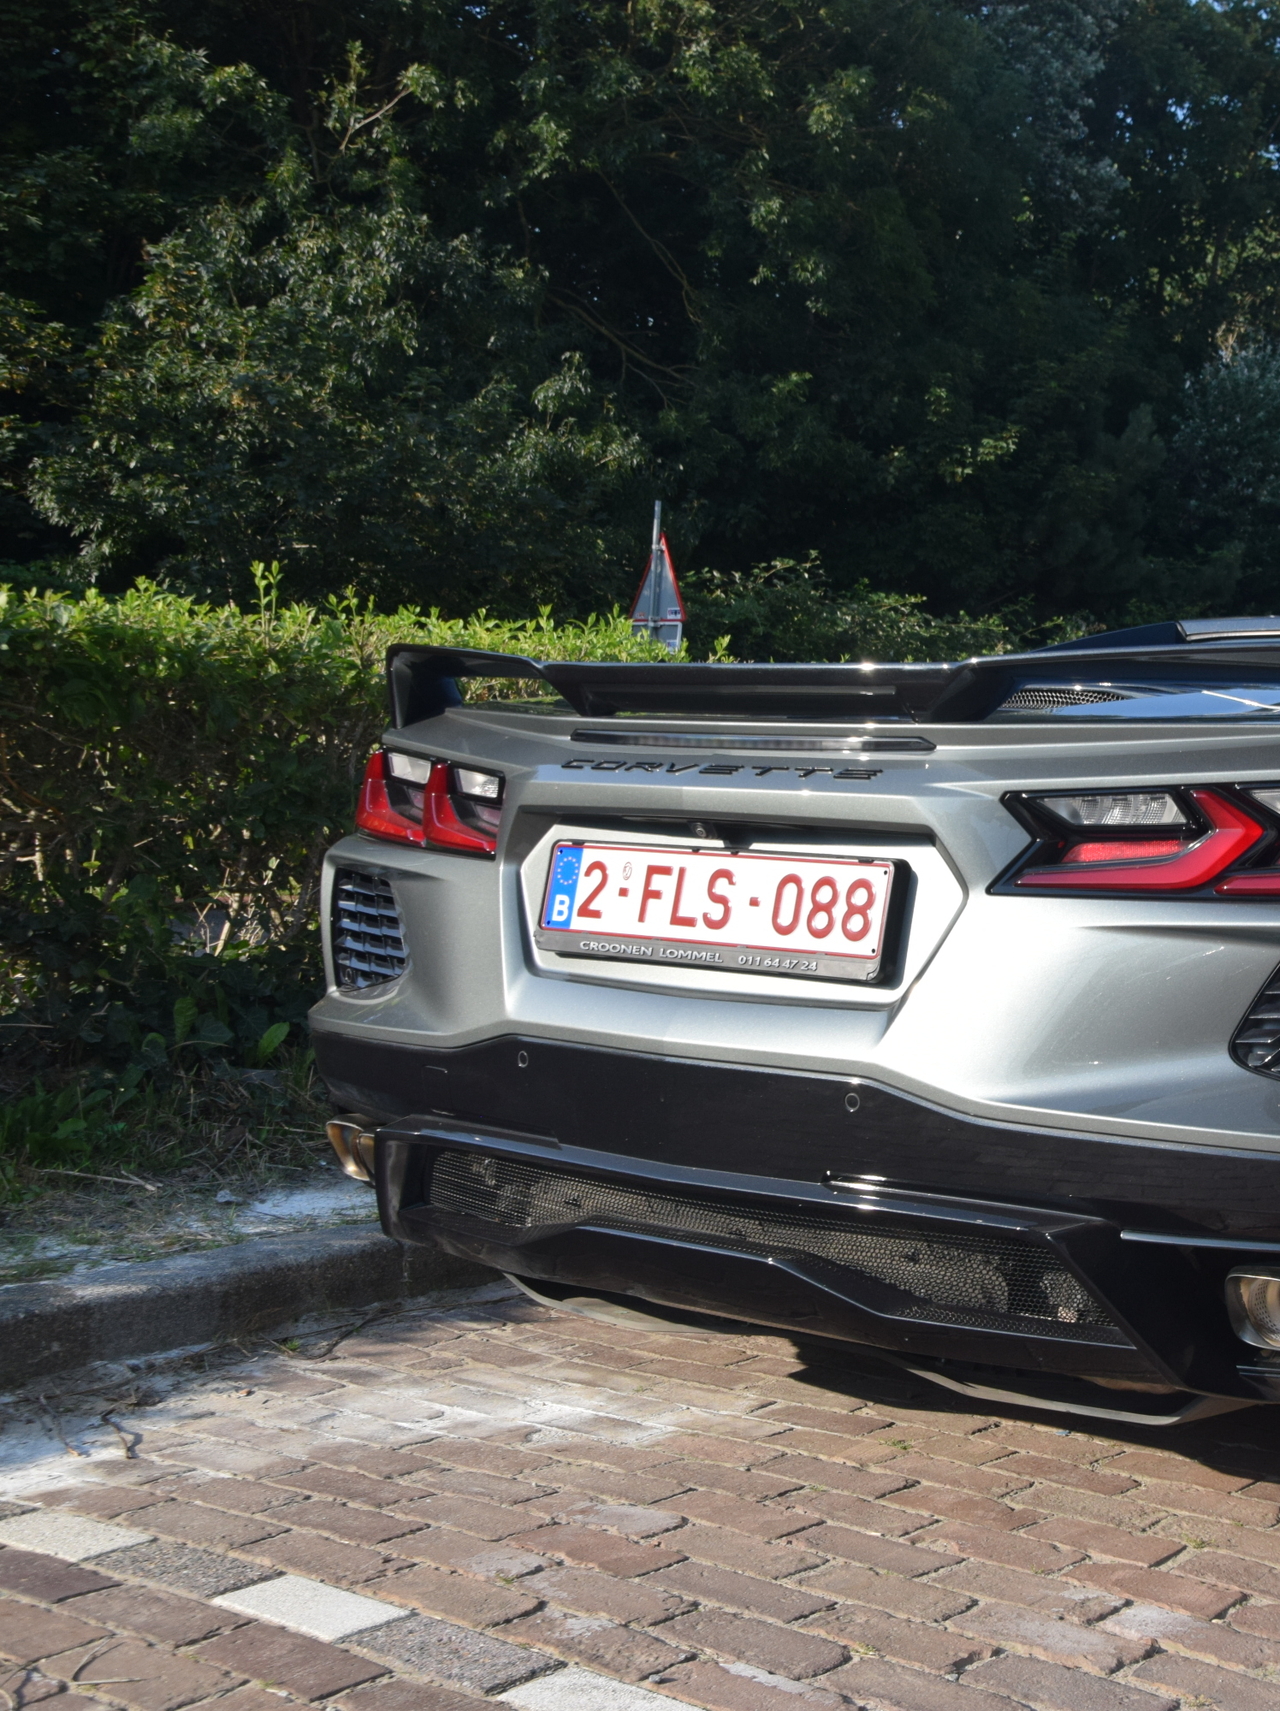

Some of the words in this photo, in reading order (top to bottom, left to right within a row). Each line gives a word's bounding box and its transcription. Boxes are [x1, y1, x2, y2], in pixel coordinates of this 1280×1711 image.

[560, 758, 884, 781] CORVETTE
[552, 894, 570, 922] B
[579, 941, 653, 957] CROONEN
[658, 947, 723, 963] LOMMEL
[737, 954, 761, 967] 011
[763, 956, 780, 968] 64
[781, 959, 799, 970] 47
[800, 960, 818, 971] 24
